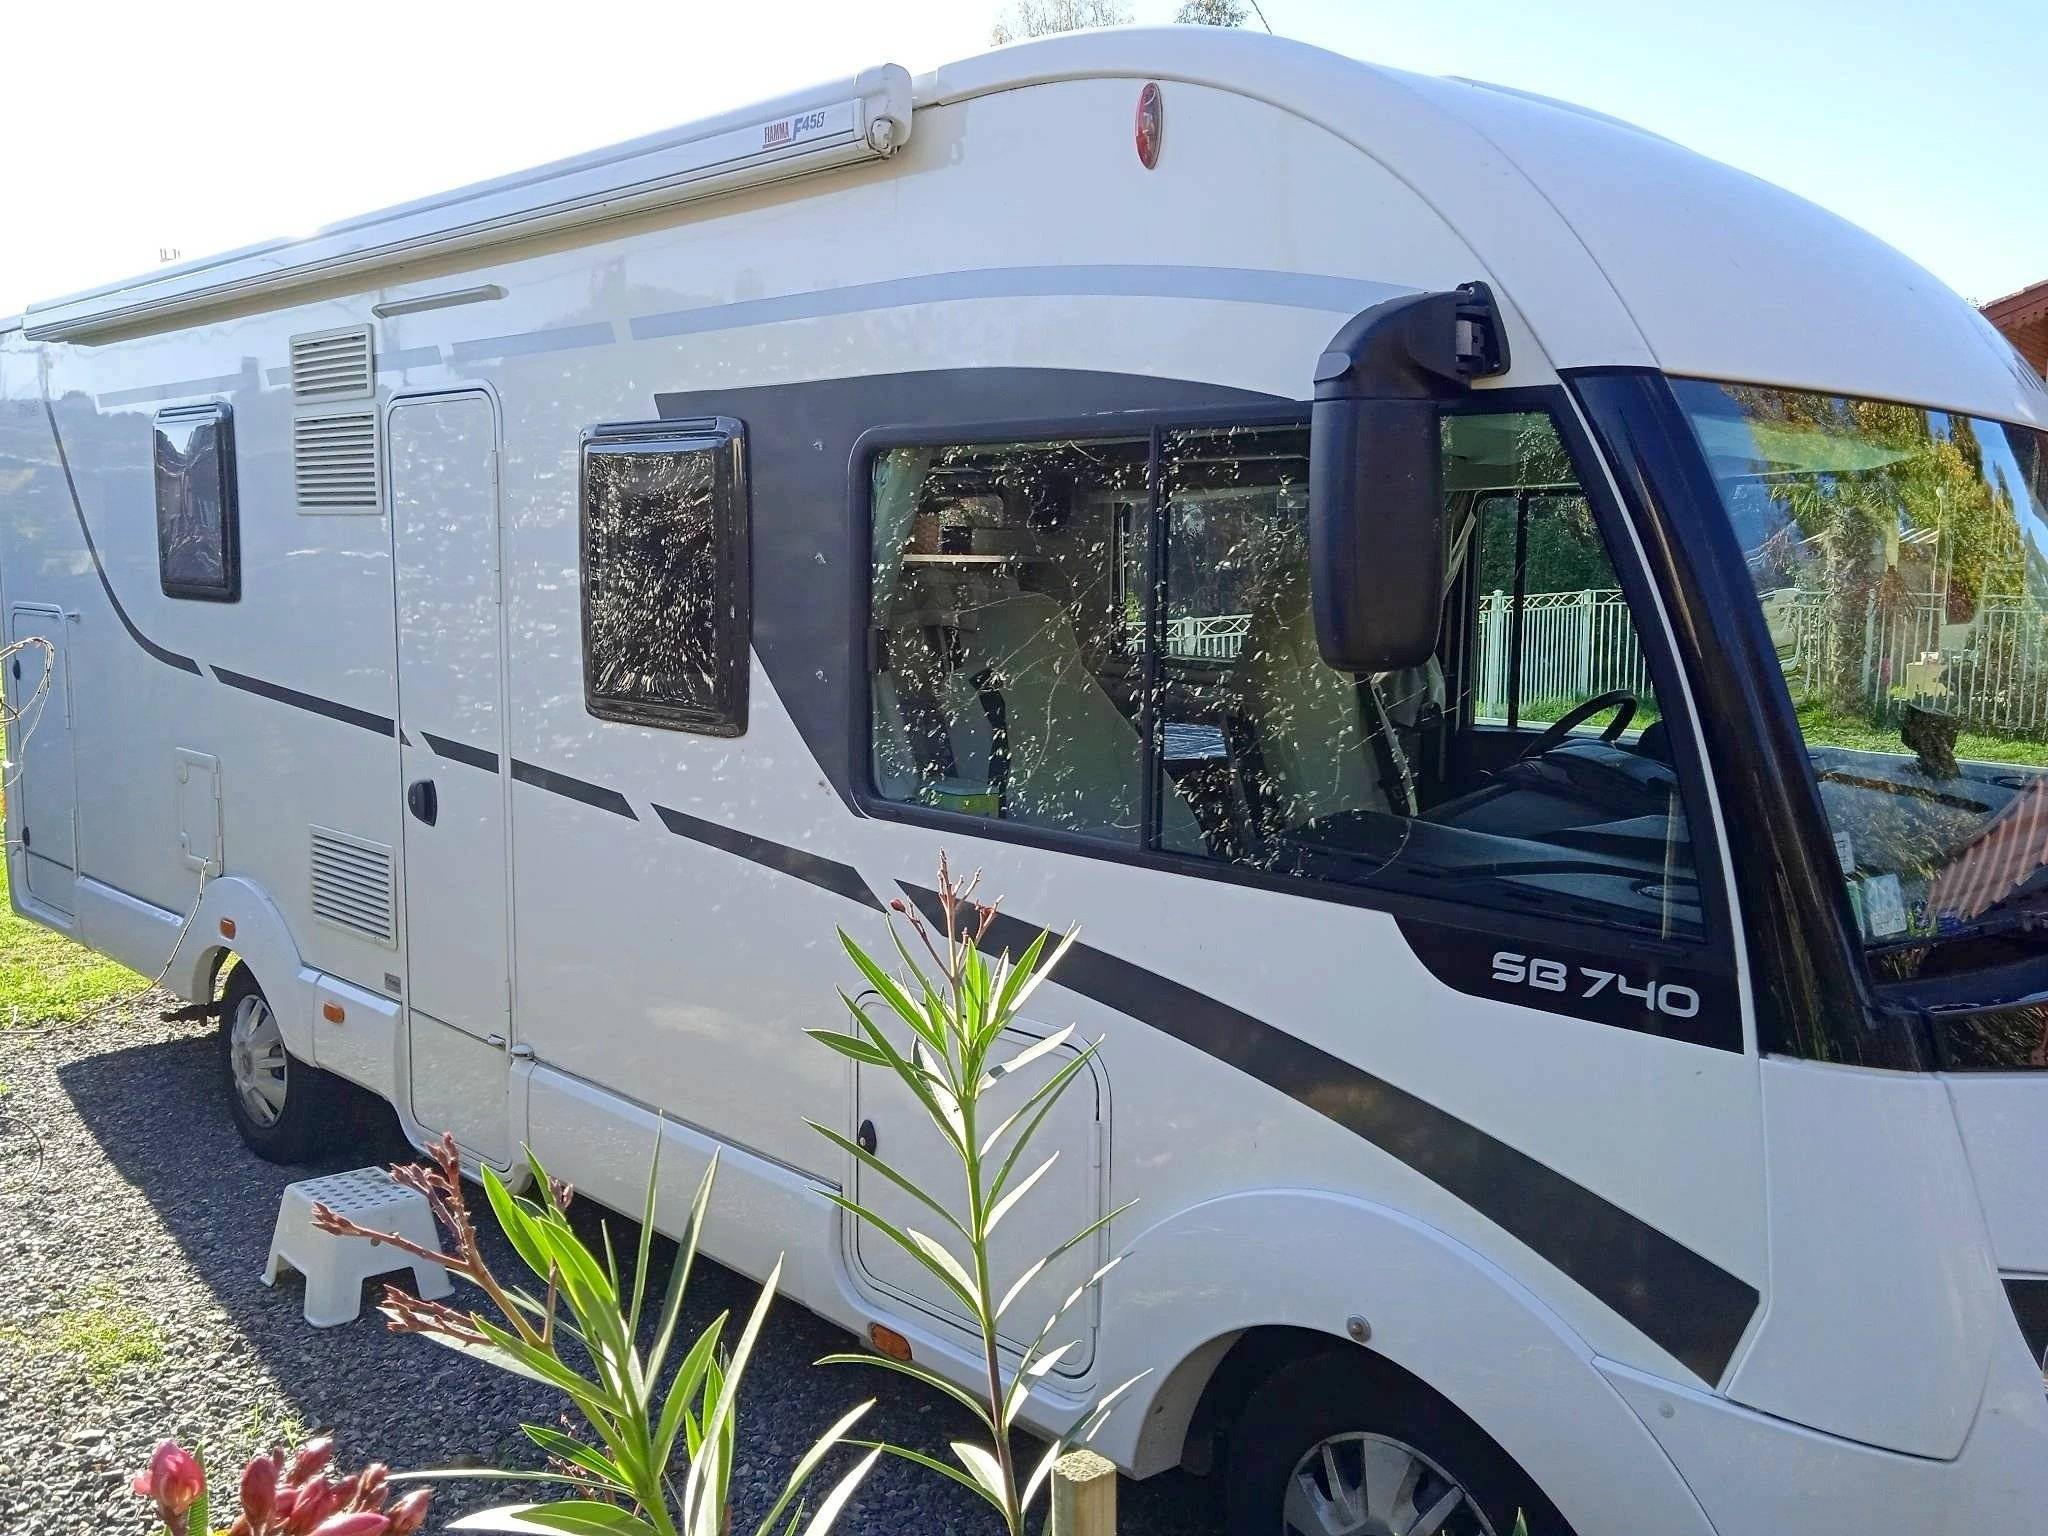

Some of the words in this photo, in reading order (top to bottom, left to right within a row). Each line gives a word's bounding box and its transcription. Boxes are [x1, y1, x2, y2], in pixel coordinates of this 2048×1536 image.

[764, 121, 790, 143] FIAMMA
[1492, 951, 1568, 992] SB
[1580, 967, 1700, 1018] 740
